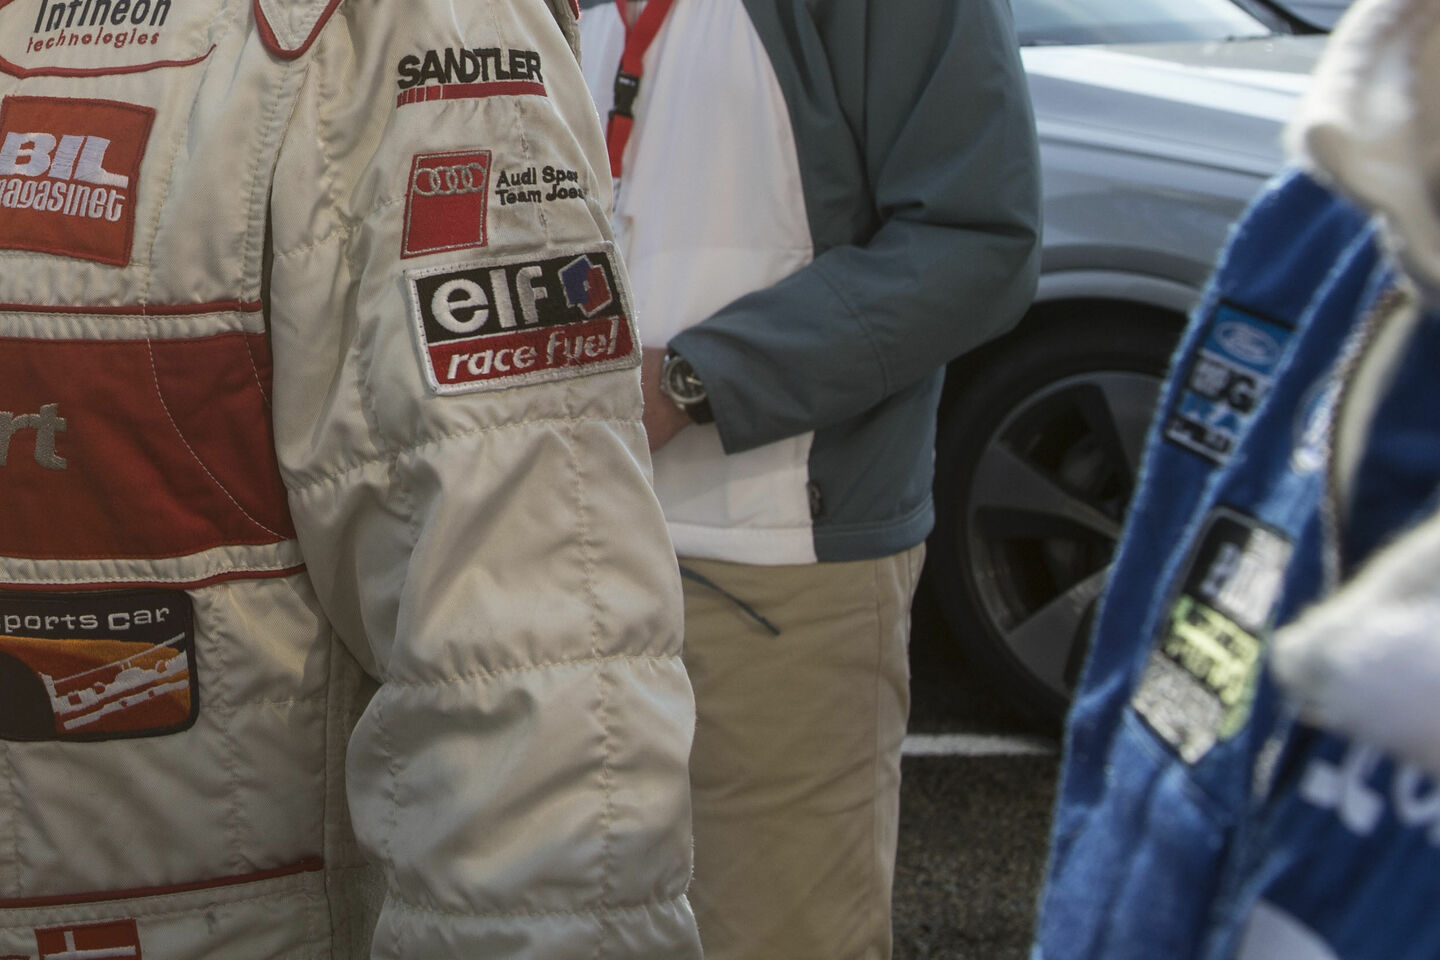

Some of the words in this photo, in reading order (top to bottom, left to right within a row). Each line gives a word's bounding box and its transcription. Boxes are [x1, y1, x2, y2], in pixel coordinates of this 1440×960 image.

[27, 27, 160, 54] technologies
[397, 47, 543, 89] SANDTLER
[496, 167, 537, 188] Audi
[495, 188, 542, 206] Team
[431, 266, 548, 334] elf
[447, 343, 535, 380] race
[546, 316, 620, 366] fuel
